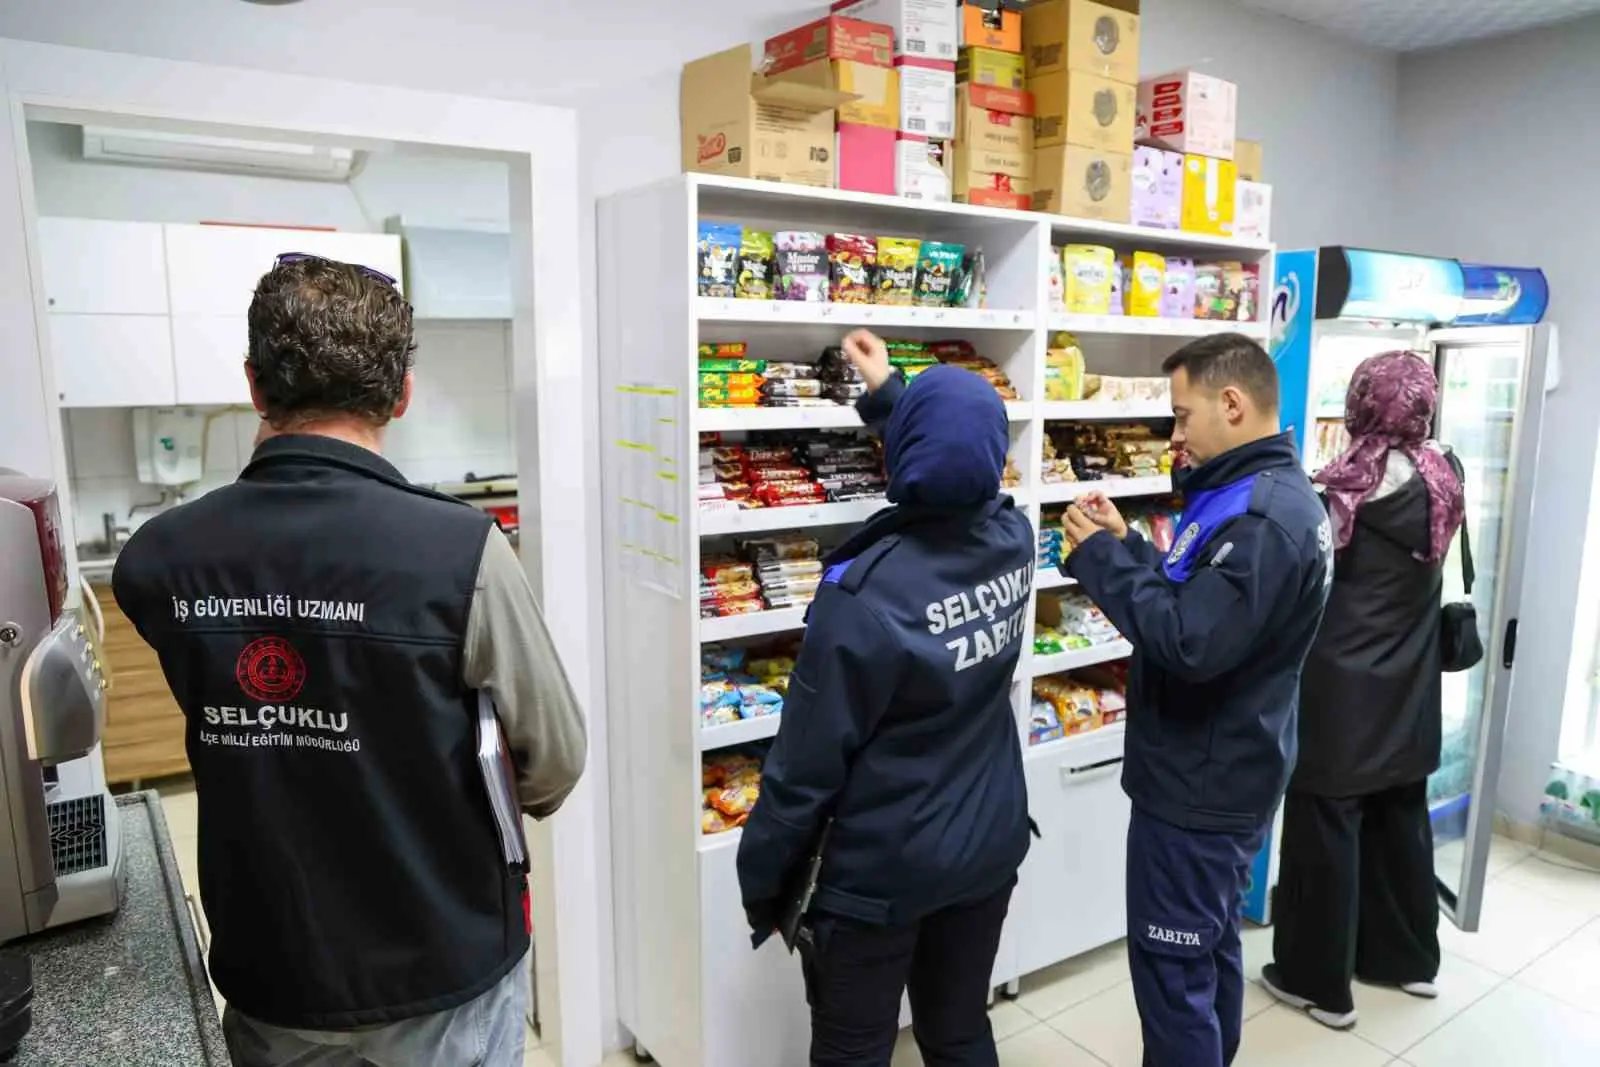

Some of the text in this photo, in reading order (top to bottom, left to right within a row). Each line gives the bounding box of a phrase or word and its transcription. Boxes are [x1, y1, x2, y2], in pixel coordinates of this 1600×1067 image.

[172, 594, 365, 622] İŞ GÜVENLİĞİ UZMANI
[203, 705, 349, 733] SELÇUKLU
[200, 729, 219, 745] LÇE
[221, 731, 250, 747] MİLLİ
[252, 731, 293, 747] EĞİTİM
[1148, 924, 1201, 946] ZABITA
